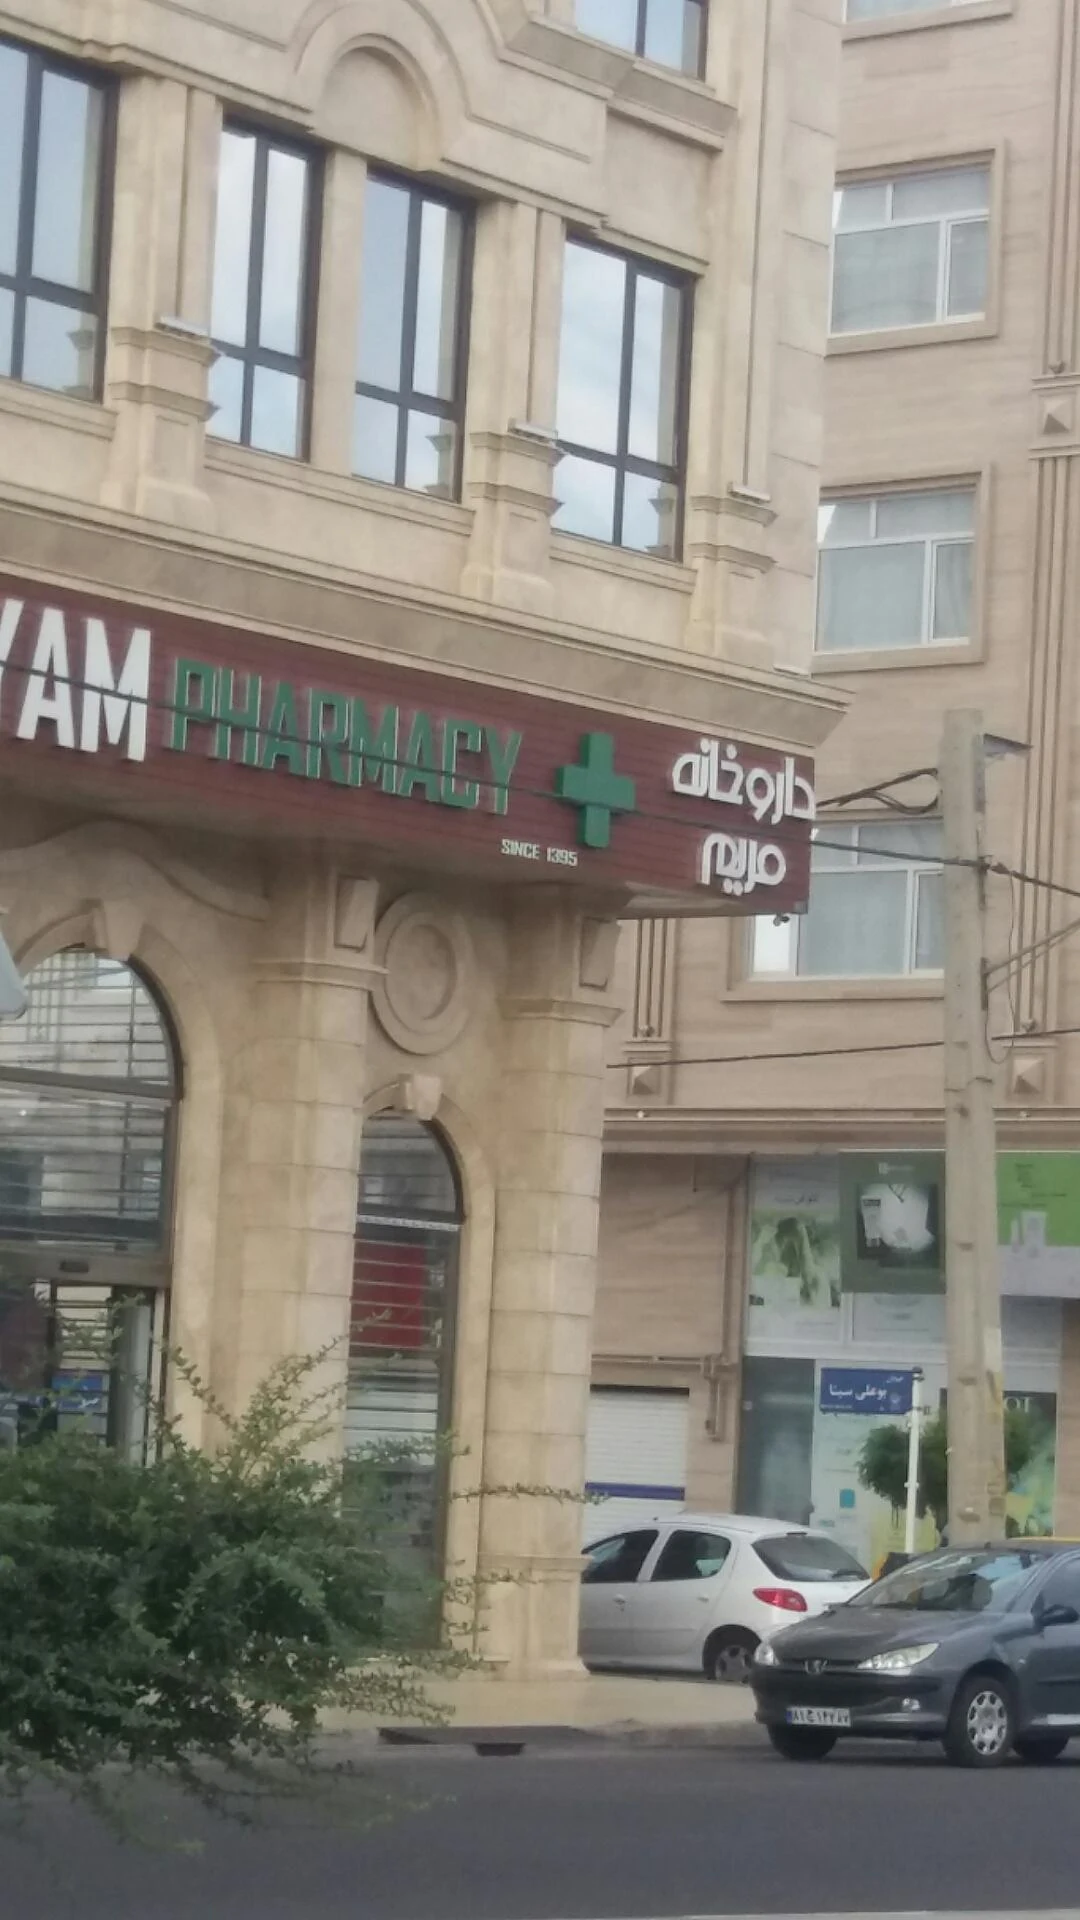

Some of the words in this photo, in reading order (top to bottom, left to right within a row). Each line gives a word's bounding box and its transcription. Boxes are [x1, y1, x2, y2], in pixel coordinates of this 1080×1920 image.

[168, 655, 522, 816] PHARMACY
[671, 738, 817, 825] داروخانه
[501, 838, 541, 860] SINCE
[546, 847, 578, 867] 1395
[701, 832, 787, 897] مریم
